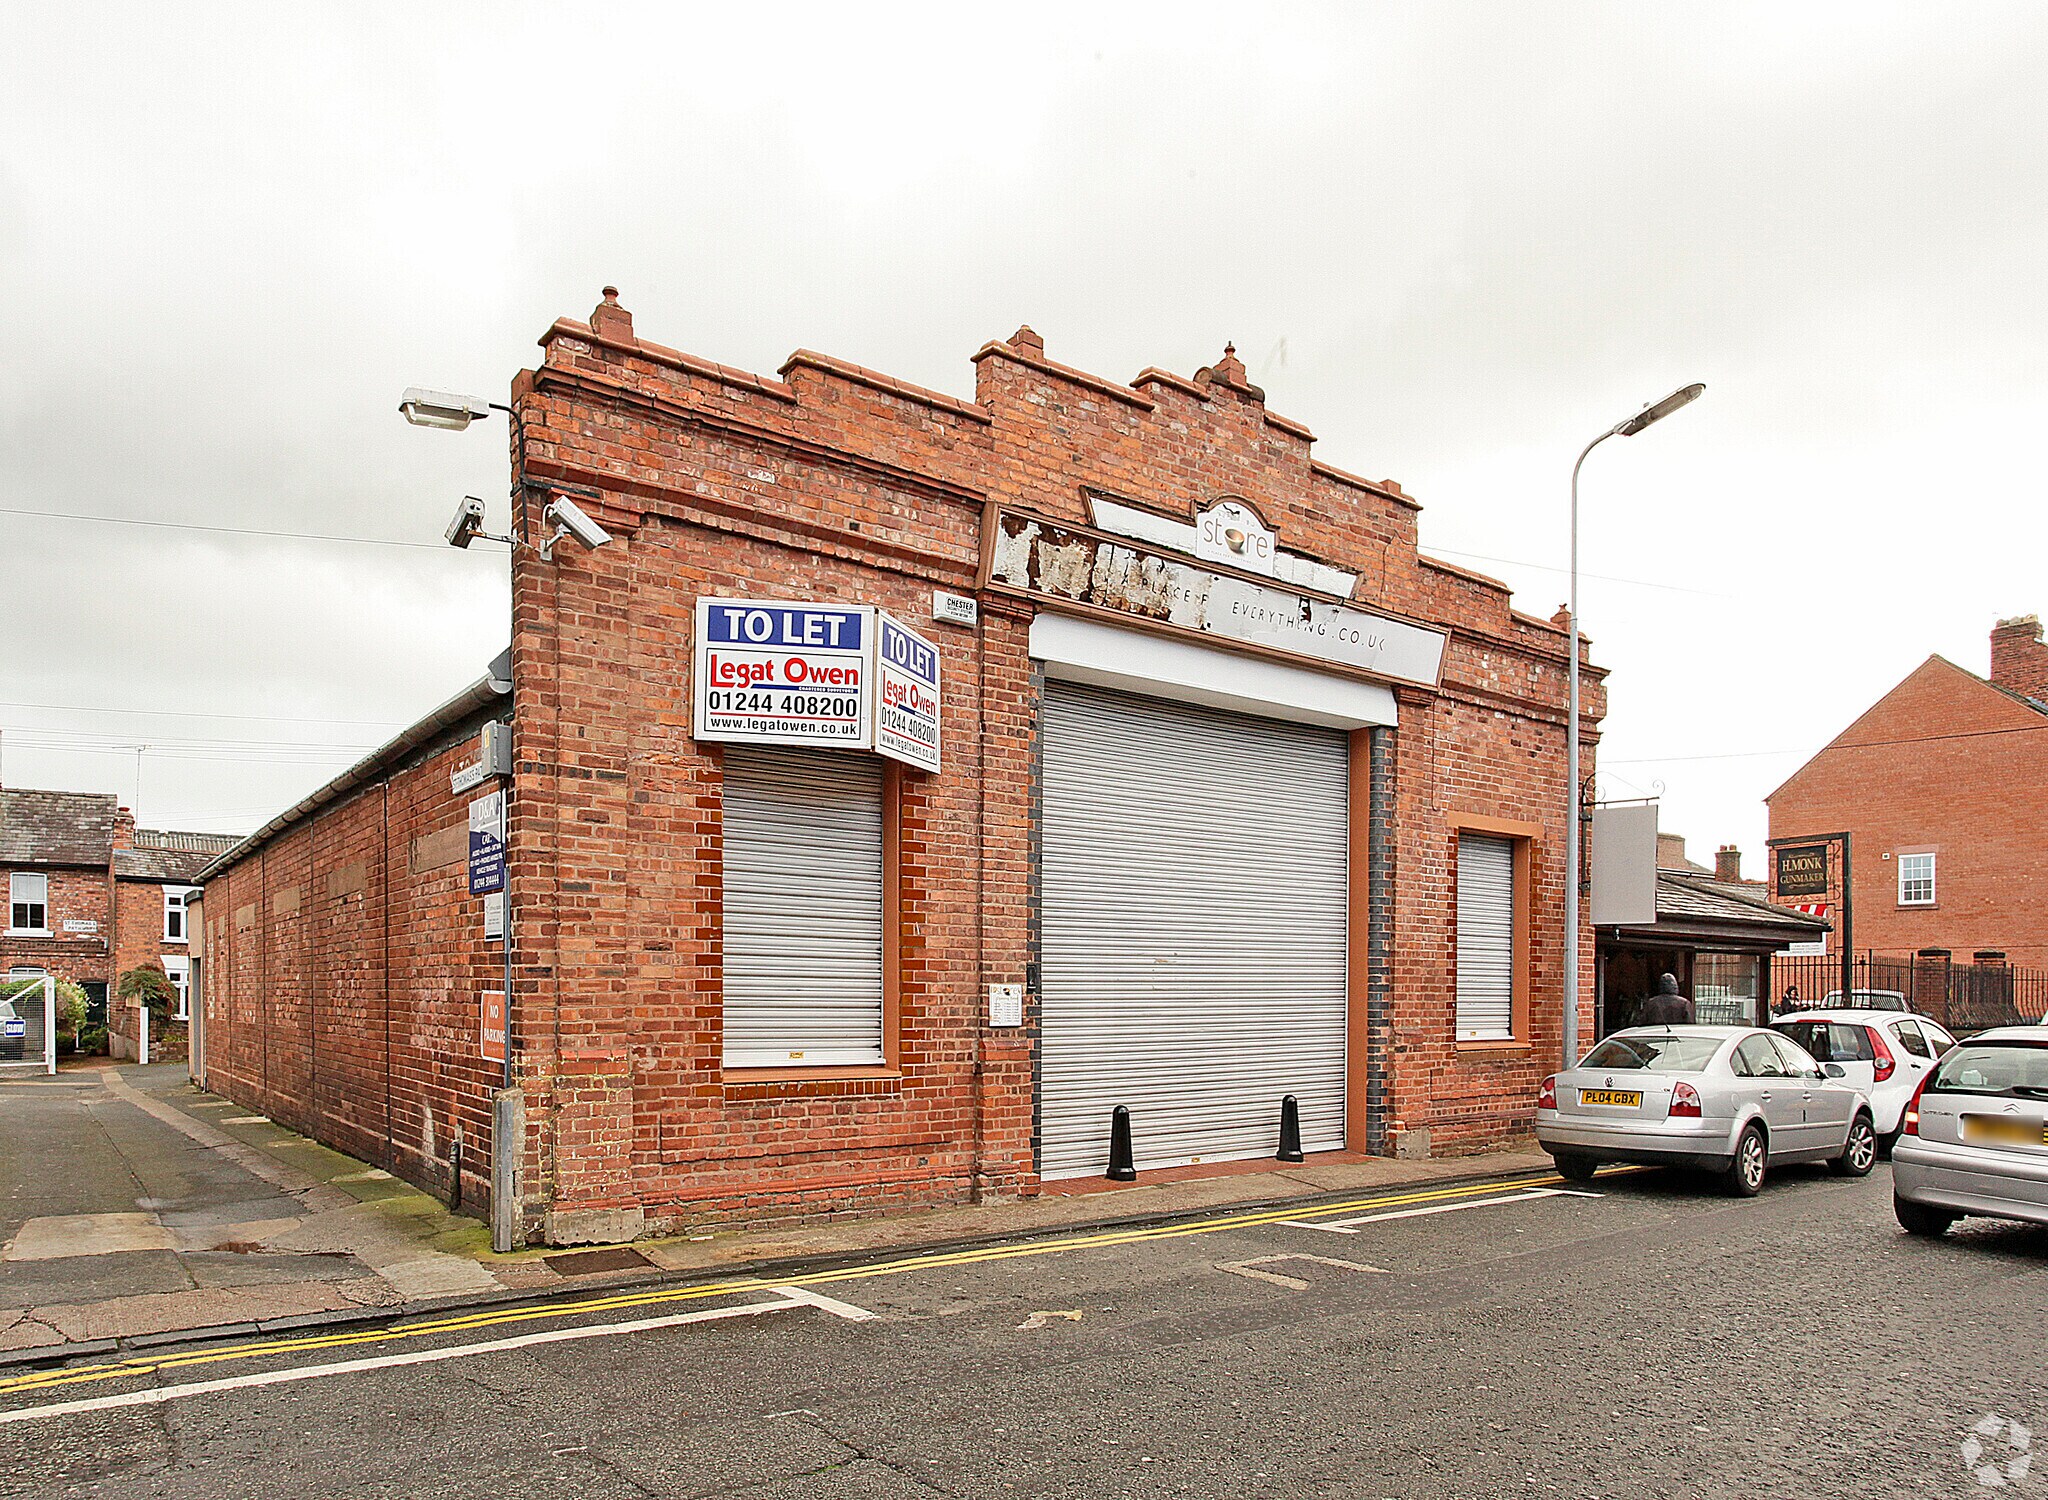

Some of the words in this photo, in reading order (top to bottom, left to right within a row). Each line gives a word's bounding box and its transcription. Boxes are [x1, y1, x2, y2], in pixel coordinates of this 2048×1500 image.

[946, 598, 974, 611] CHESTER
[723, 608, 774, 644] TO
[782, 613, 847, 646] LET
[887, 627, 908, 666] TO
[909, 639, 931, 680] LET
[710, 654, 774, 689] Legat
[784, 657, 859, 686] Owen
[709, 691, 773, 713] 01244
[780, 695, 857, 717] 408200
[882, 669, 907, 708] Legat
[910, 684, 936, 718] Owen
[710, 717, 857, 735] www.legatowen.co.uk
[881, 706, 906, 733] 01244
[908, 719, 936, 745] 408200
[881, 732, 936, 761] www.legatowen.co.uk
[1782, 857, 1822, 872] H.MONK
[1780, 872, 1825, 884] GUNMAKER
[489, 1004, 499, 1019] NO
[1585, 1091, 1612, 1103] PL04
[1613, 1093, 1636, 1104] GBX
